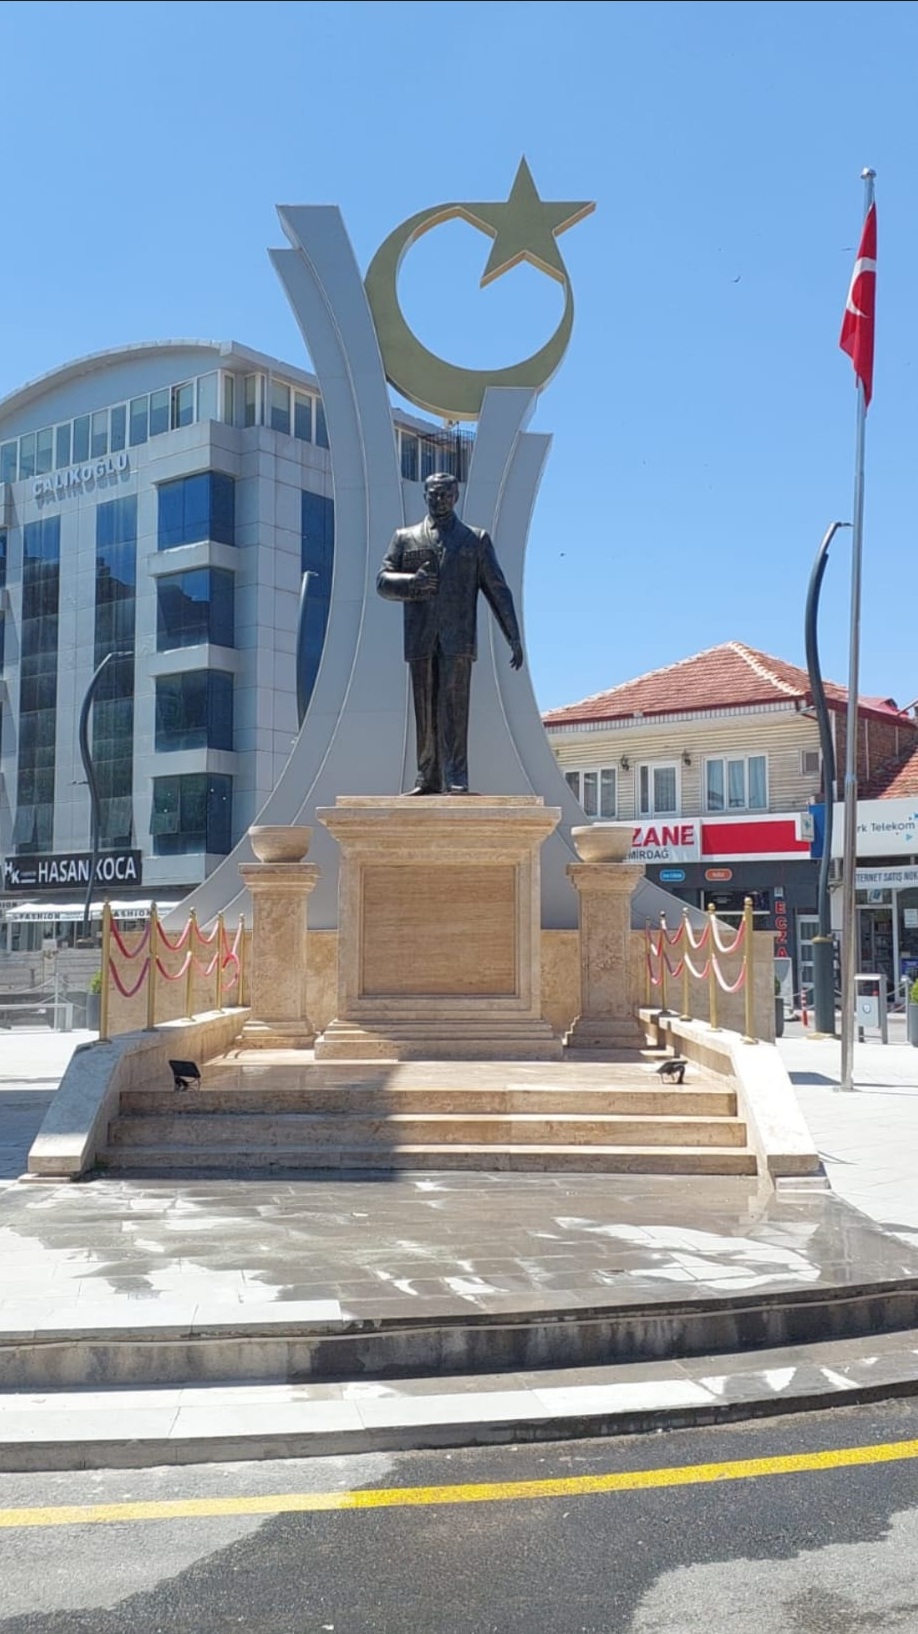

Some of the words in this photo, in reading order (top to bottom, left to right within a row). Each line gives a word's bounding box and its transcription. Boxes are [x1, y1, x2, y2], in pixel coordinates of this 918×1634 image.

[871, 821, 915, 832] Telekom
[632, 825, 694, 847] ZANE
[629, 848, 669, 860] MİRDAĞ
[38, 859, 90, 883] HASAN
[856, 872, 881, 882] TERNET
[775, 901, 789, 958] ECZA
